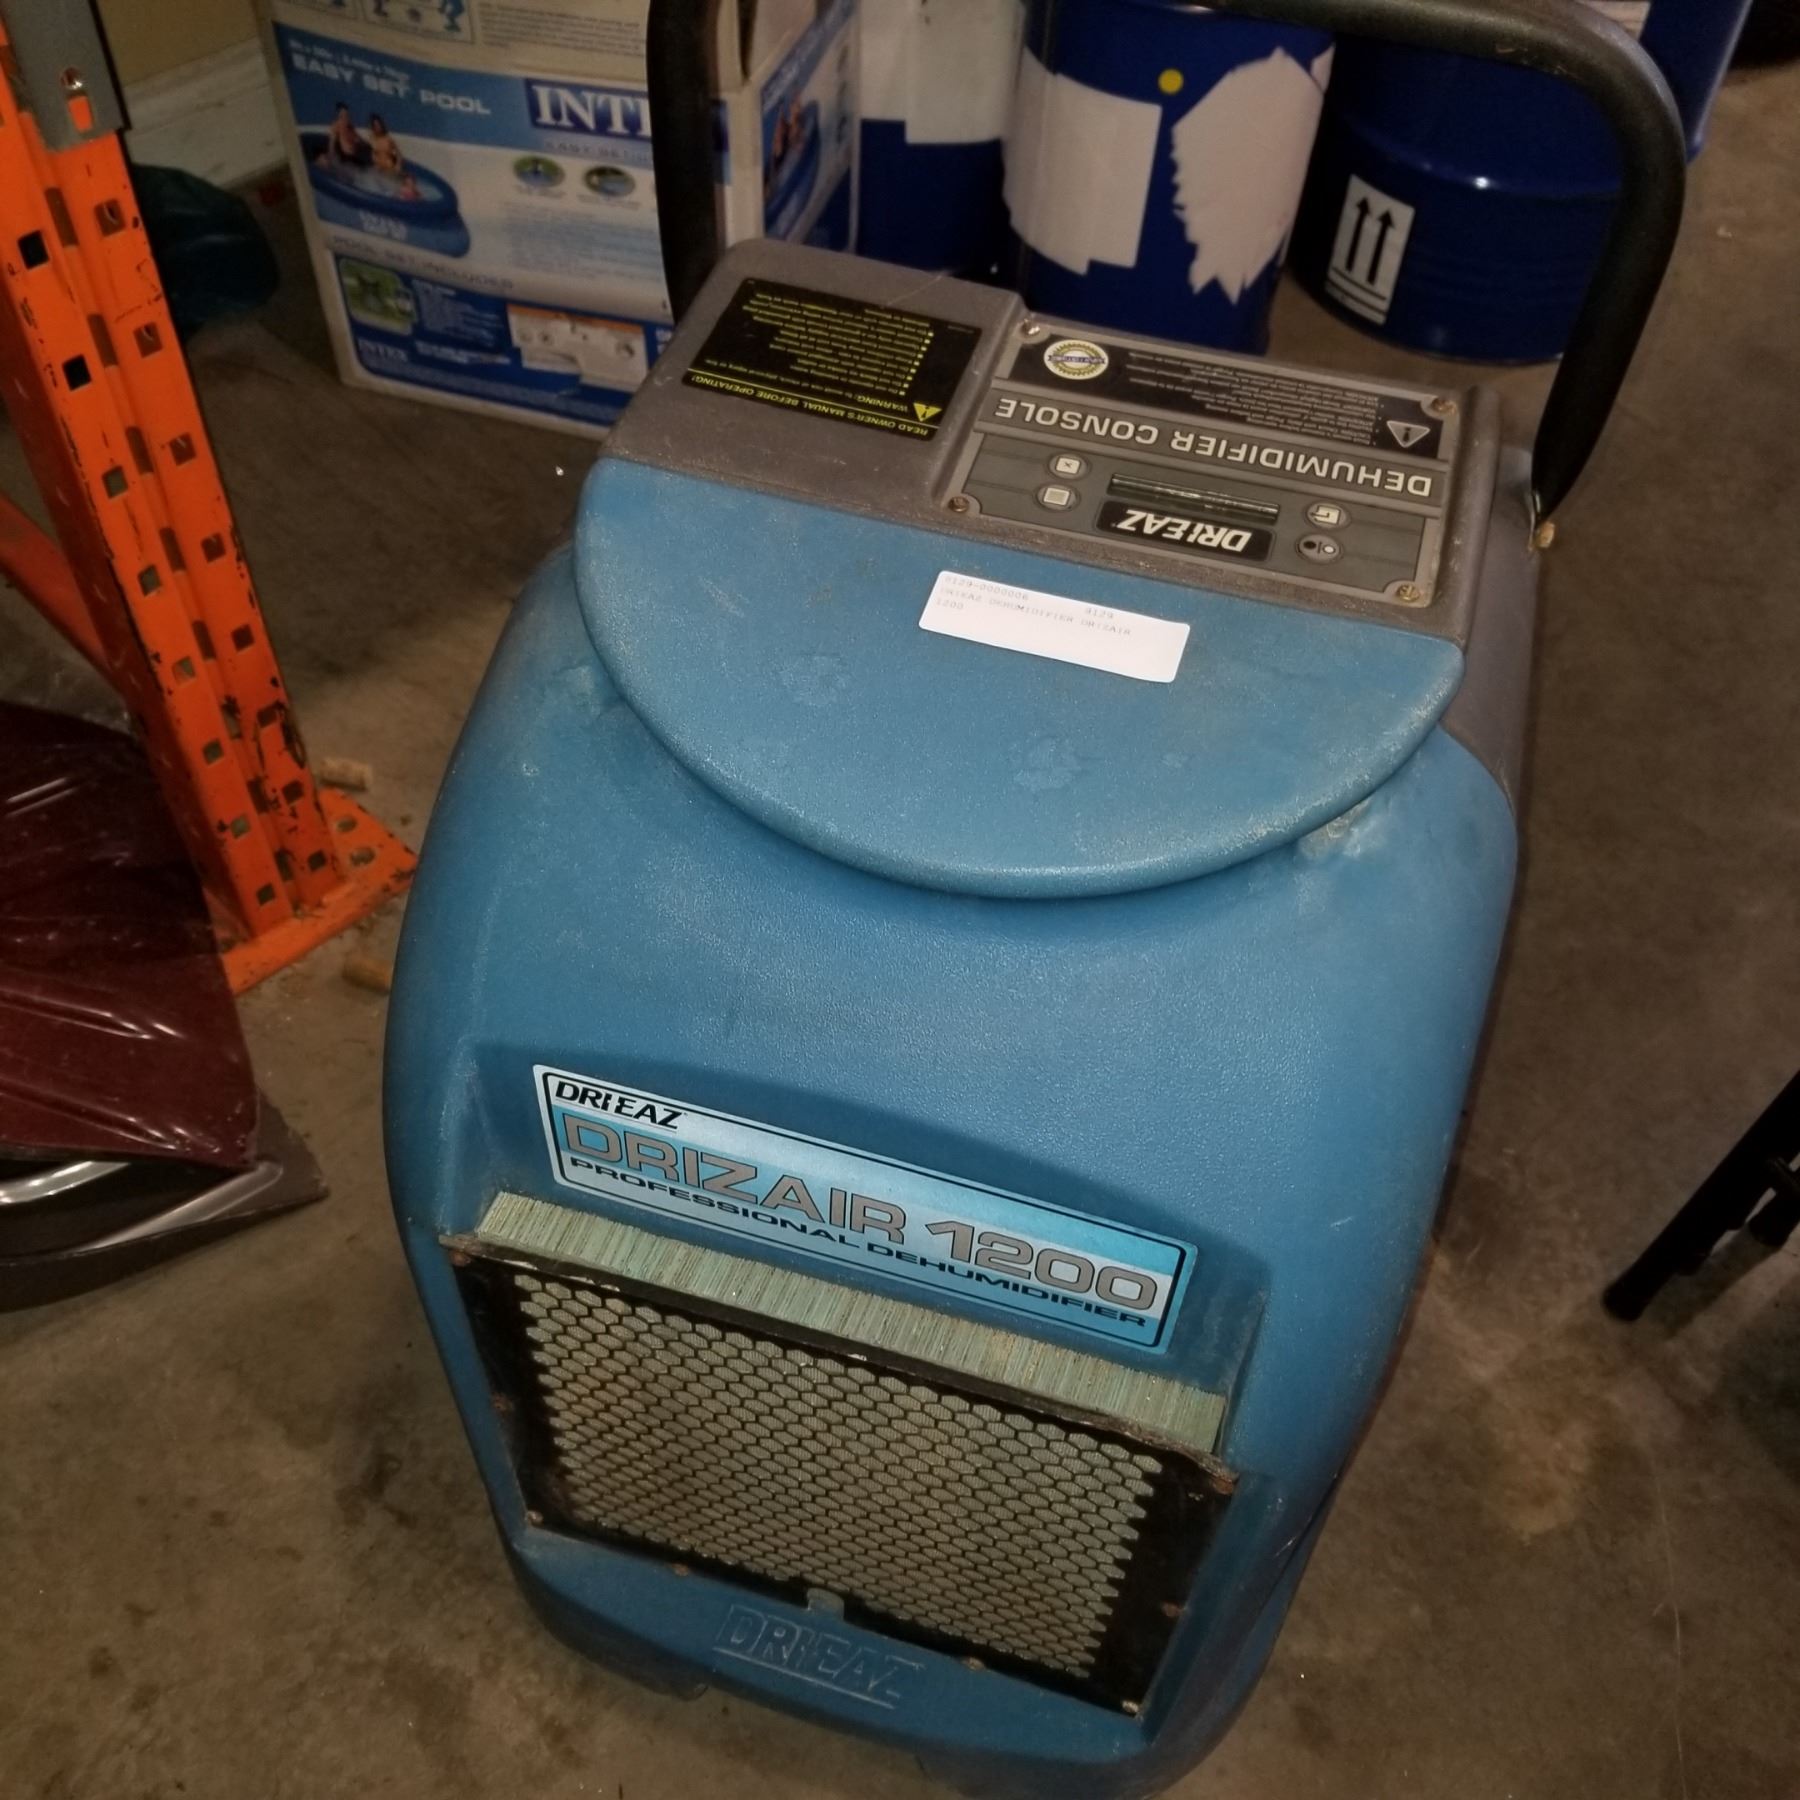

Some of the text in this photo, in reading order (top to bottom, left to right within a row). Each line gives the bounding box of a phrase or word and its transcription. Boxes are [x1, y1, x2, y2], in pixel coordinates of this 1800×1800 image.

[291, 53, 355, 84] EASY
[419, 89, 492, 116] POOL
[689, 374, 929, 435] READ OWNER'S MANUAL BEFORE OPERATING!
[851, 393, 910, 412] WARNING:
[994, 397, 1432, 497] DEHUMIDIFIER CONSOLE
[562, 1112, 1158, 1312] DRIZAIR 1200
[569, 1156, 1147, 1328] PROFESSIONAL DEHUMIDIFIER
